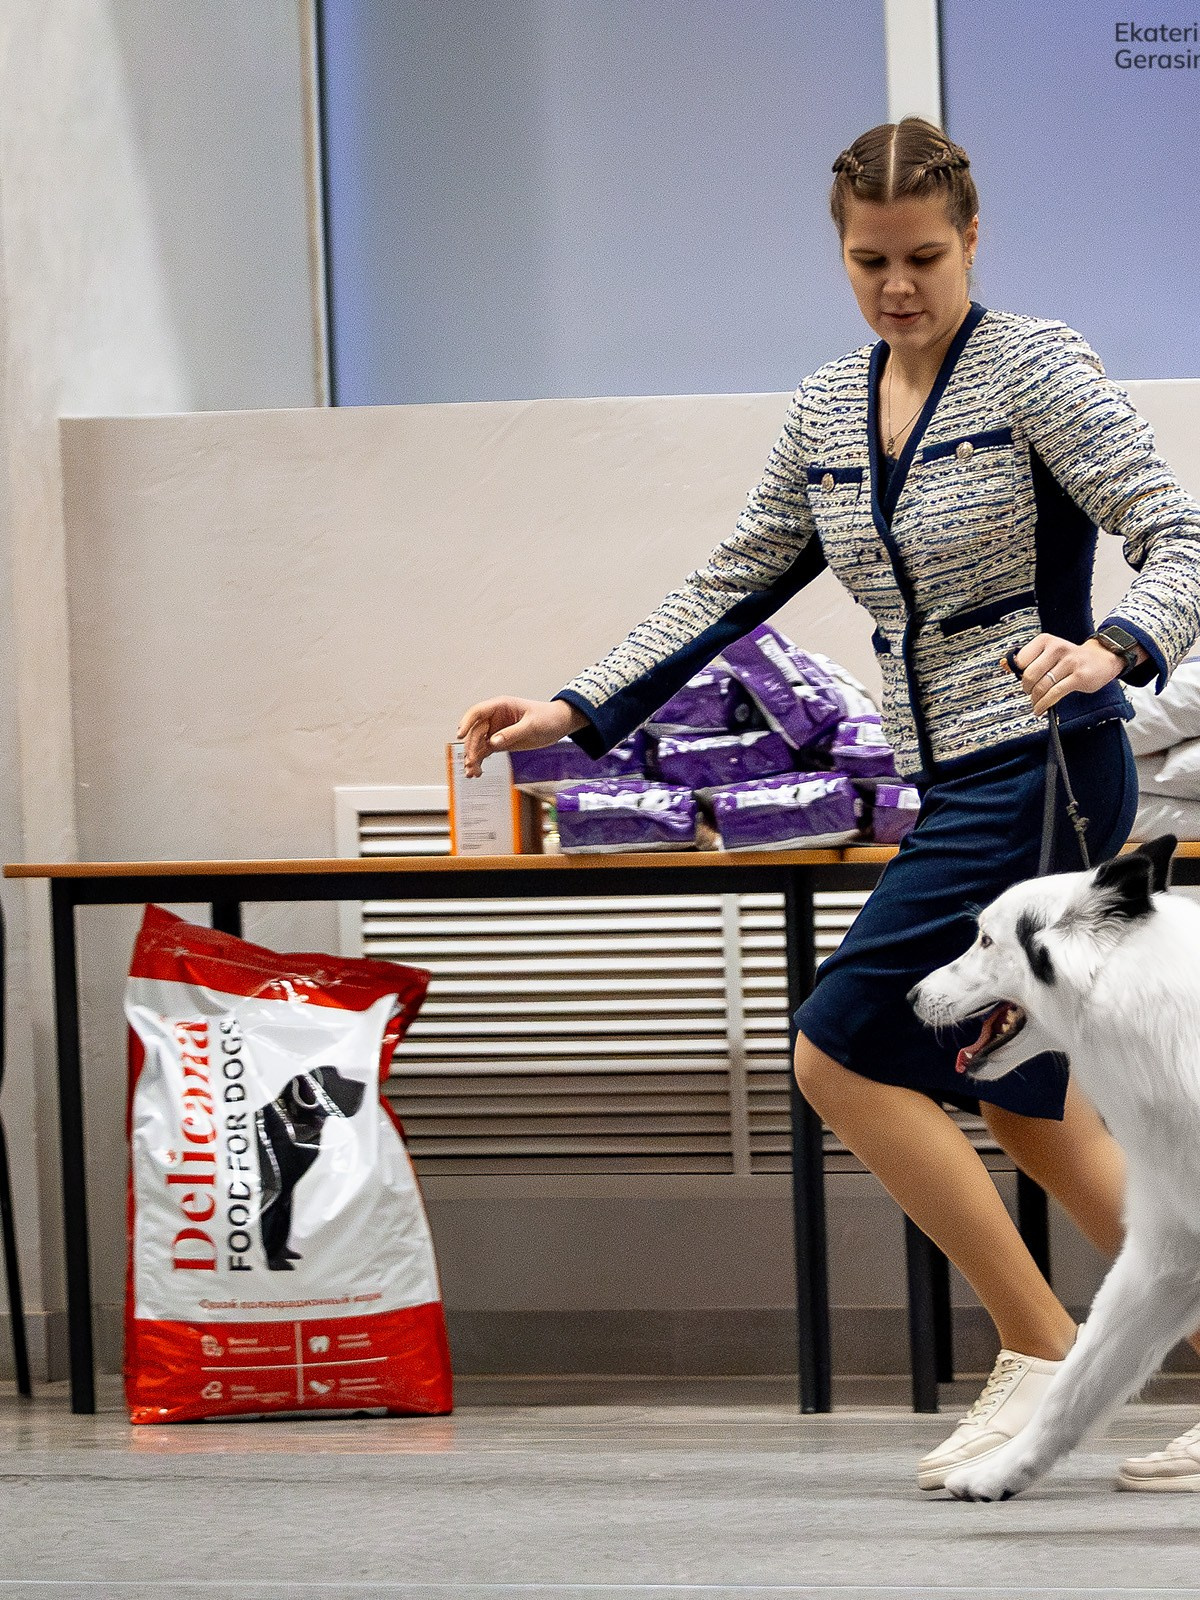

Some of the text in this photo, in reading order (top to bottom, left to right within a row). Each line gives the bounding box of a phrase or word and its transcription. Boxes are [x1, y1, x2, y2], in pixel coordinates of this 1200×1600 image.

[163, 1020, 217, 1272] Delicana
[225, 1112, 250, 1171] FOR
[227, 1181, 252, 1271] FOOD
